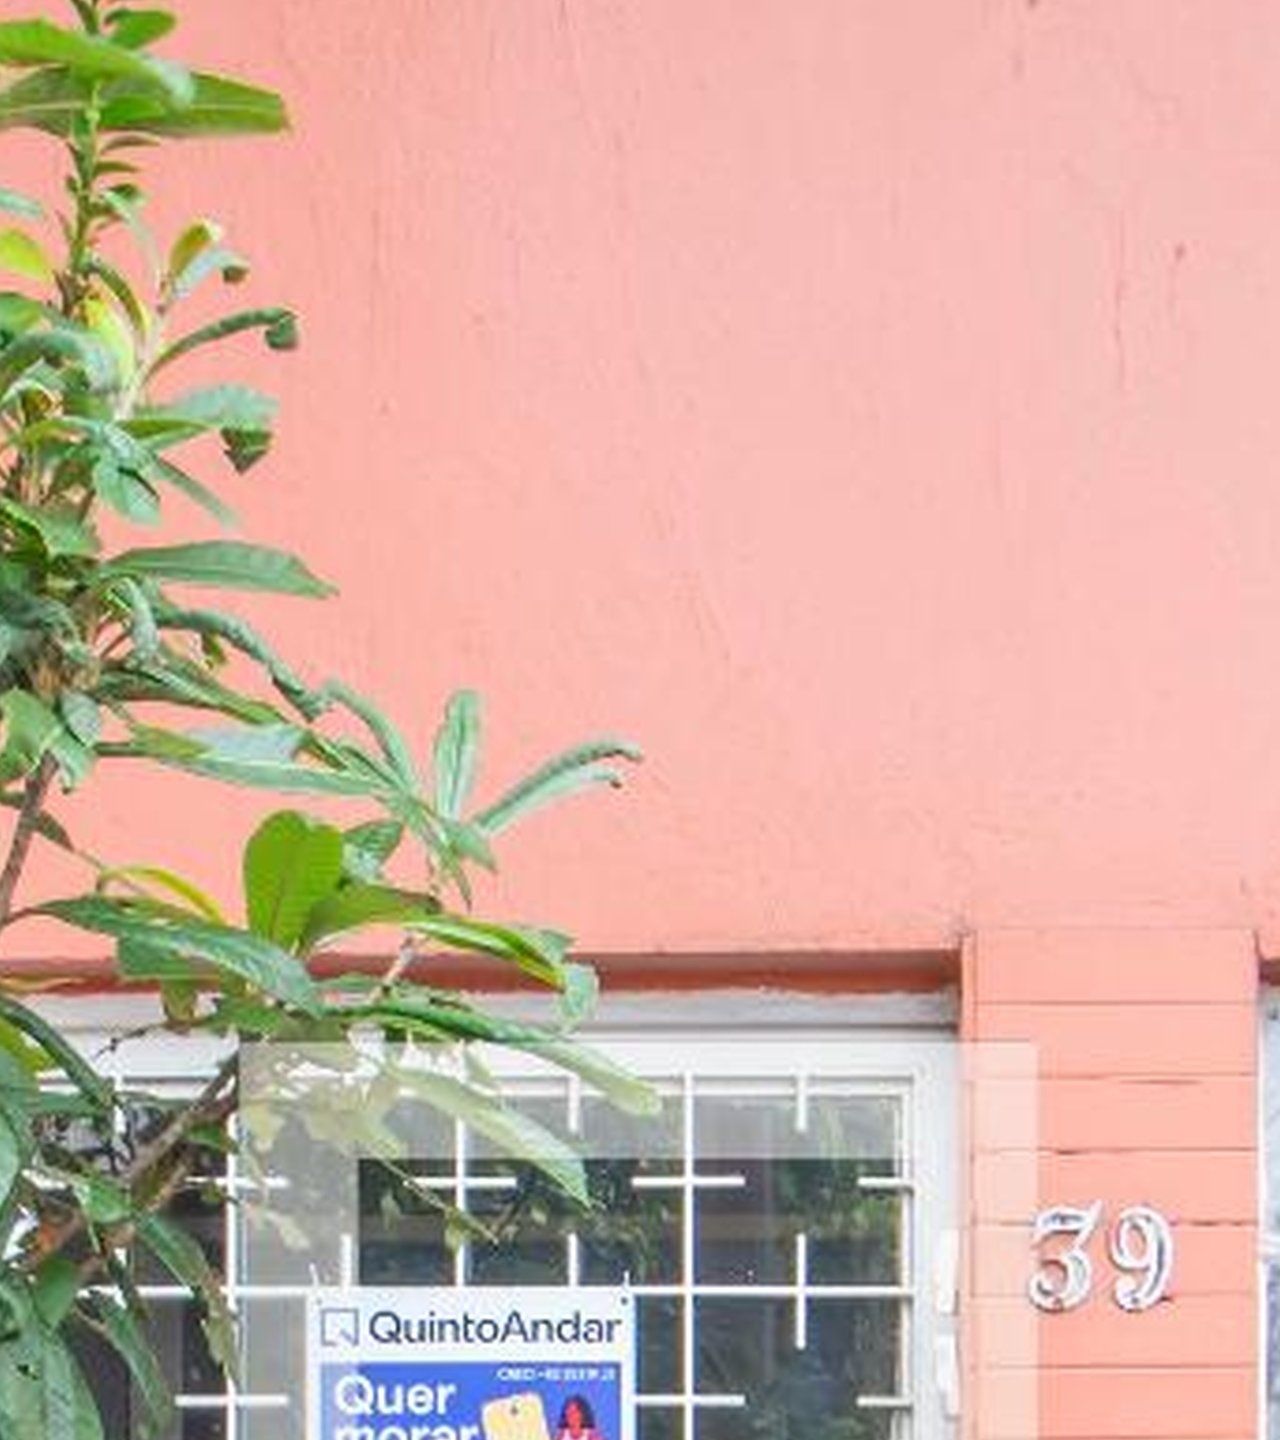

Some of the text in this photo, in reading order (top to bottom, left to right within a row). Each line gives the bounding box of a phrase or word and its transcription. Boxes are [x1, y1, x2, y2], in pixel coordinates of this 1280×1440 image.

[1028, 1199, 1173, 1312] 39
[369, 1310, 622, 1345] QuintoAndar
[335, 1375, 457, 1415] Quer
